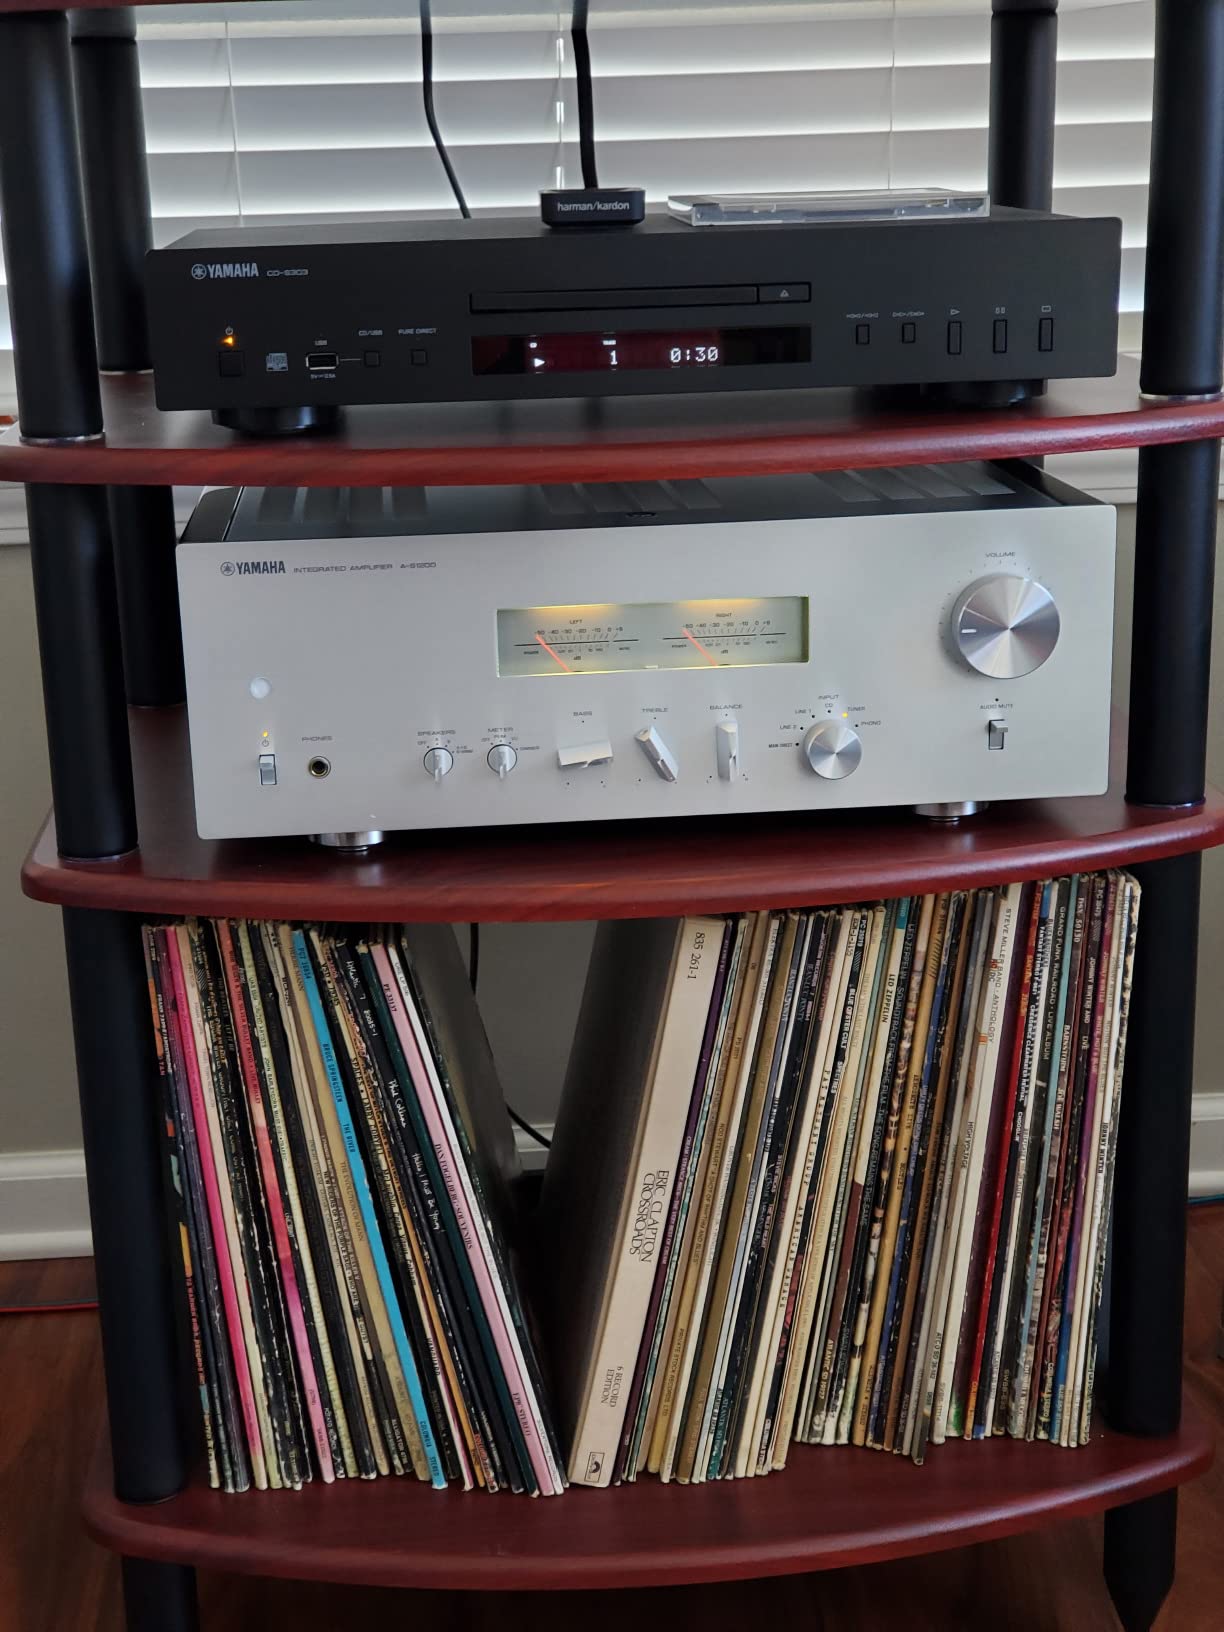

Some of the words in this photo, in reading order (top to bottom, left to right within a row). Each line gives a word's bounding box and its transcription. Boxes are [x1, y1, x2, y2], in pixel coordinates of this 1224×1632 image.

[557, 200, 630, 212] harman/kardon
[207, 262, 259, 278] YAMAHA
[609, 350, 618, 366] 1
[670, 346, 718, 363] 0:30
[235, 560, 286, 575] YAMAHA
[349, 564, 393, 572] AMPLIFIER
[985, 551, 1016, 559] VOLUME
[709, 703, 743, 711] BALANCE
[1001, 907, 1012, 934] STEVE
[1056, 905, 1066, 936] GRAND
[692, 931, 705, 950] 835
[997, 935, 1008, 965] MILLER
[1036, 925, 1045, 952] FANTASY
[1053, 937, 1062, 961] FUNK
[686, 952, 701, 981] 261-1
[898, 940, 912, 980] ZEPPELIN
[1033, 952, 1042, 976] STEREO
[1087, 955, 1096, 984] JOHNNY
[886, 973, 896, 987] LED
[994, 965, 1004, 989] BAND
[1048, 962, 1059, 1005] RAILROAD
[846, 987, 856, 1005] BLUE
[880, 987, 893, 1023] ZEPPELIN
[1084, 984, 1093, 1010] WINTER
[888, 985, 905, 1042] SOUNDTRACK
[986, 993, 1000, 1044] ANTHOLOGY
[1025, 1003, 1036, 1039] CREEDENCE
[1045, 1010, 1054, 1030] LIVE
[321, 1041, 333, 1063] BRUCE
[838, 1030, 848, 1049] CULT
[1042, 1031, 1051, 1060] ALBUM
[1059, 1024, 1071, 1072] BARNSTORM
[263, 1056, 271, 1072] JOHN
[350, 1055, 366, 1086] SPACES
[1021, 1039, 1032, 1078] CLEARWATER
[326, 1062, 343, 1103] SPRINGSTEEN
[386, 1078, 400, 1098] Phil
[820, 1068, 830, 1090] PAT
[1018, 1078, 1027, 1103] REVIVAL
[392, 1096, 410, 1129] Collins
[1052, 1103, 1062, 1131] WALSH
[341, 1122, 351, 1135] THE
[717, 1122, 725, 1138] ROD
[871, 1124, 882, 1148] SONG
[965, 1120, 974, 1138] HIGH
[1099, 1121, 1108, 1146] JOHNNY
[344, 1134, 356, 1154] RIVER
[711, 1137, 722, 1167] STEWART
[960, 1138, 972, 1170] VOLTAGE
[865, 1147, 878, 1186] REMAINS
[1097, 1147, 1106, 1174] WINTER
[433, 1141, 445, 1160] DAN
[439, 1159, 459, 1205] FOGELBERG
[453, 1206, 474, 1251] SOUVENIRS
[653, 1168, 670, 1197] ERIC
[325, 1184, 336, 1208] RIDERS
[336, 1229, 347, 1255] PURPLE
[627, 1171, 656, 1257] CROSSROADS
[639, 1199, 664, 1264] CLAPTON
[673, 1327, 684, 1353] PRIVATE
[822, 1337, 834, 1370] ATLANTIC
[669, 1353, 679, 1374] STOCK
[599, 1367, 615, 1405] EDITION
[607, 1371, 623, 1409] RECORD
[516, 1407, 532, 1438] STEREO
[418, 1419, 433, 1449] COLUMBIA
[428, 1455, 440, 1477] STEREO
